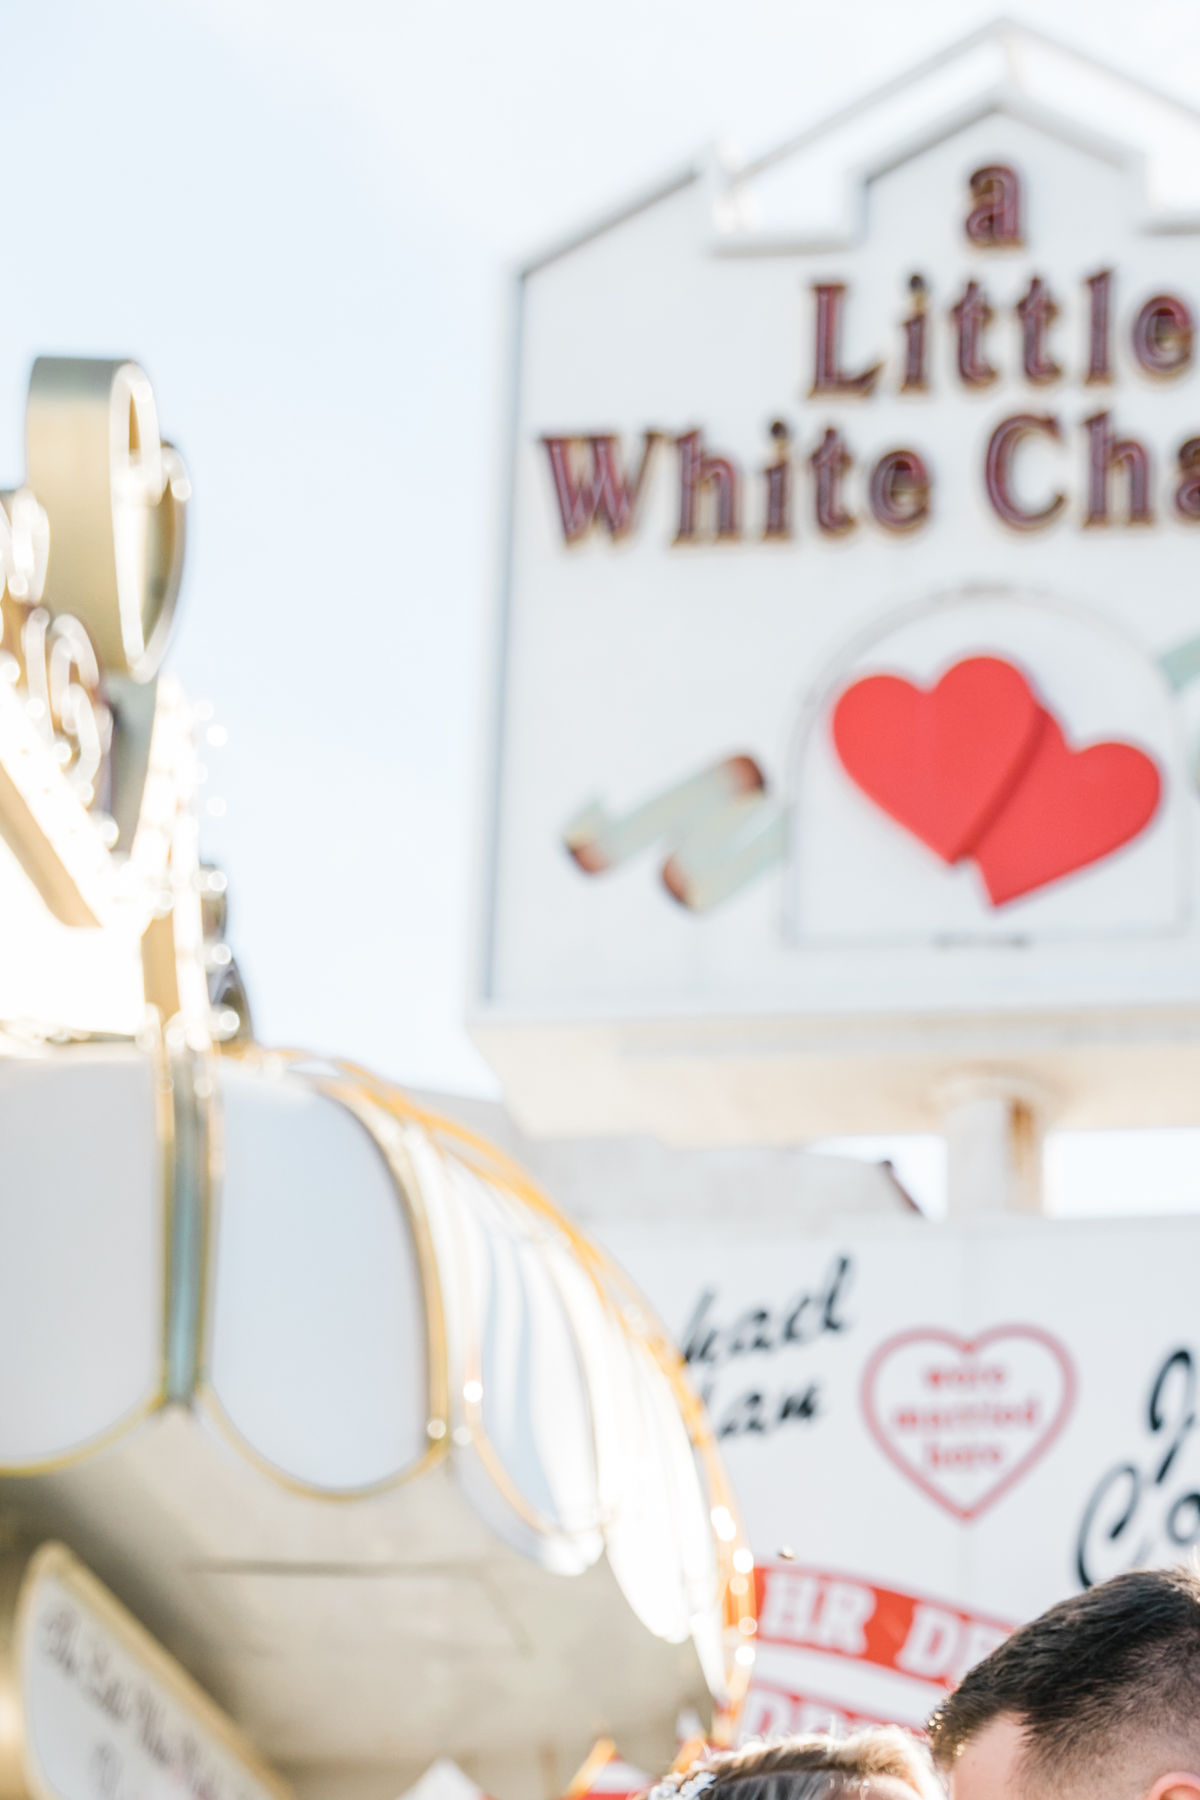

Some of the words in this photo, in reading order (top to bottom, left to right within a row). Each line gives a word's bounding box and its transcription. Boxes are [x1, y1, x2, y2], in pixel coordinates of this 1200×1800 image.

[963, 162, 1025, 249] a
[808, 268, 1198, 400] Little
[540, 420, 932, 547] White
[759, 1571, 876, 1655] HR
